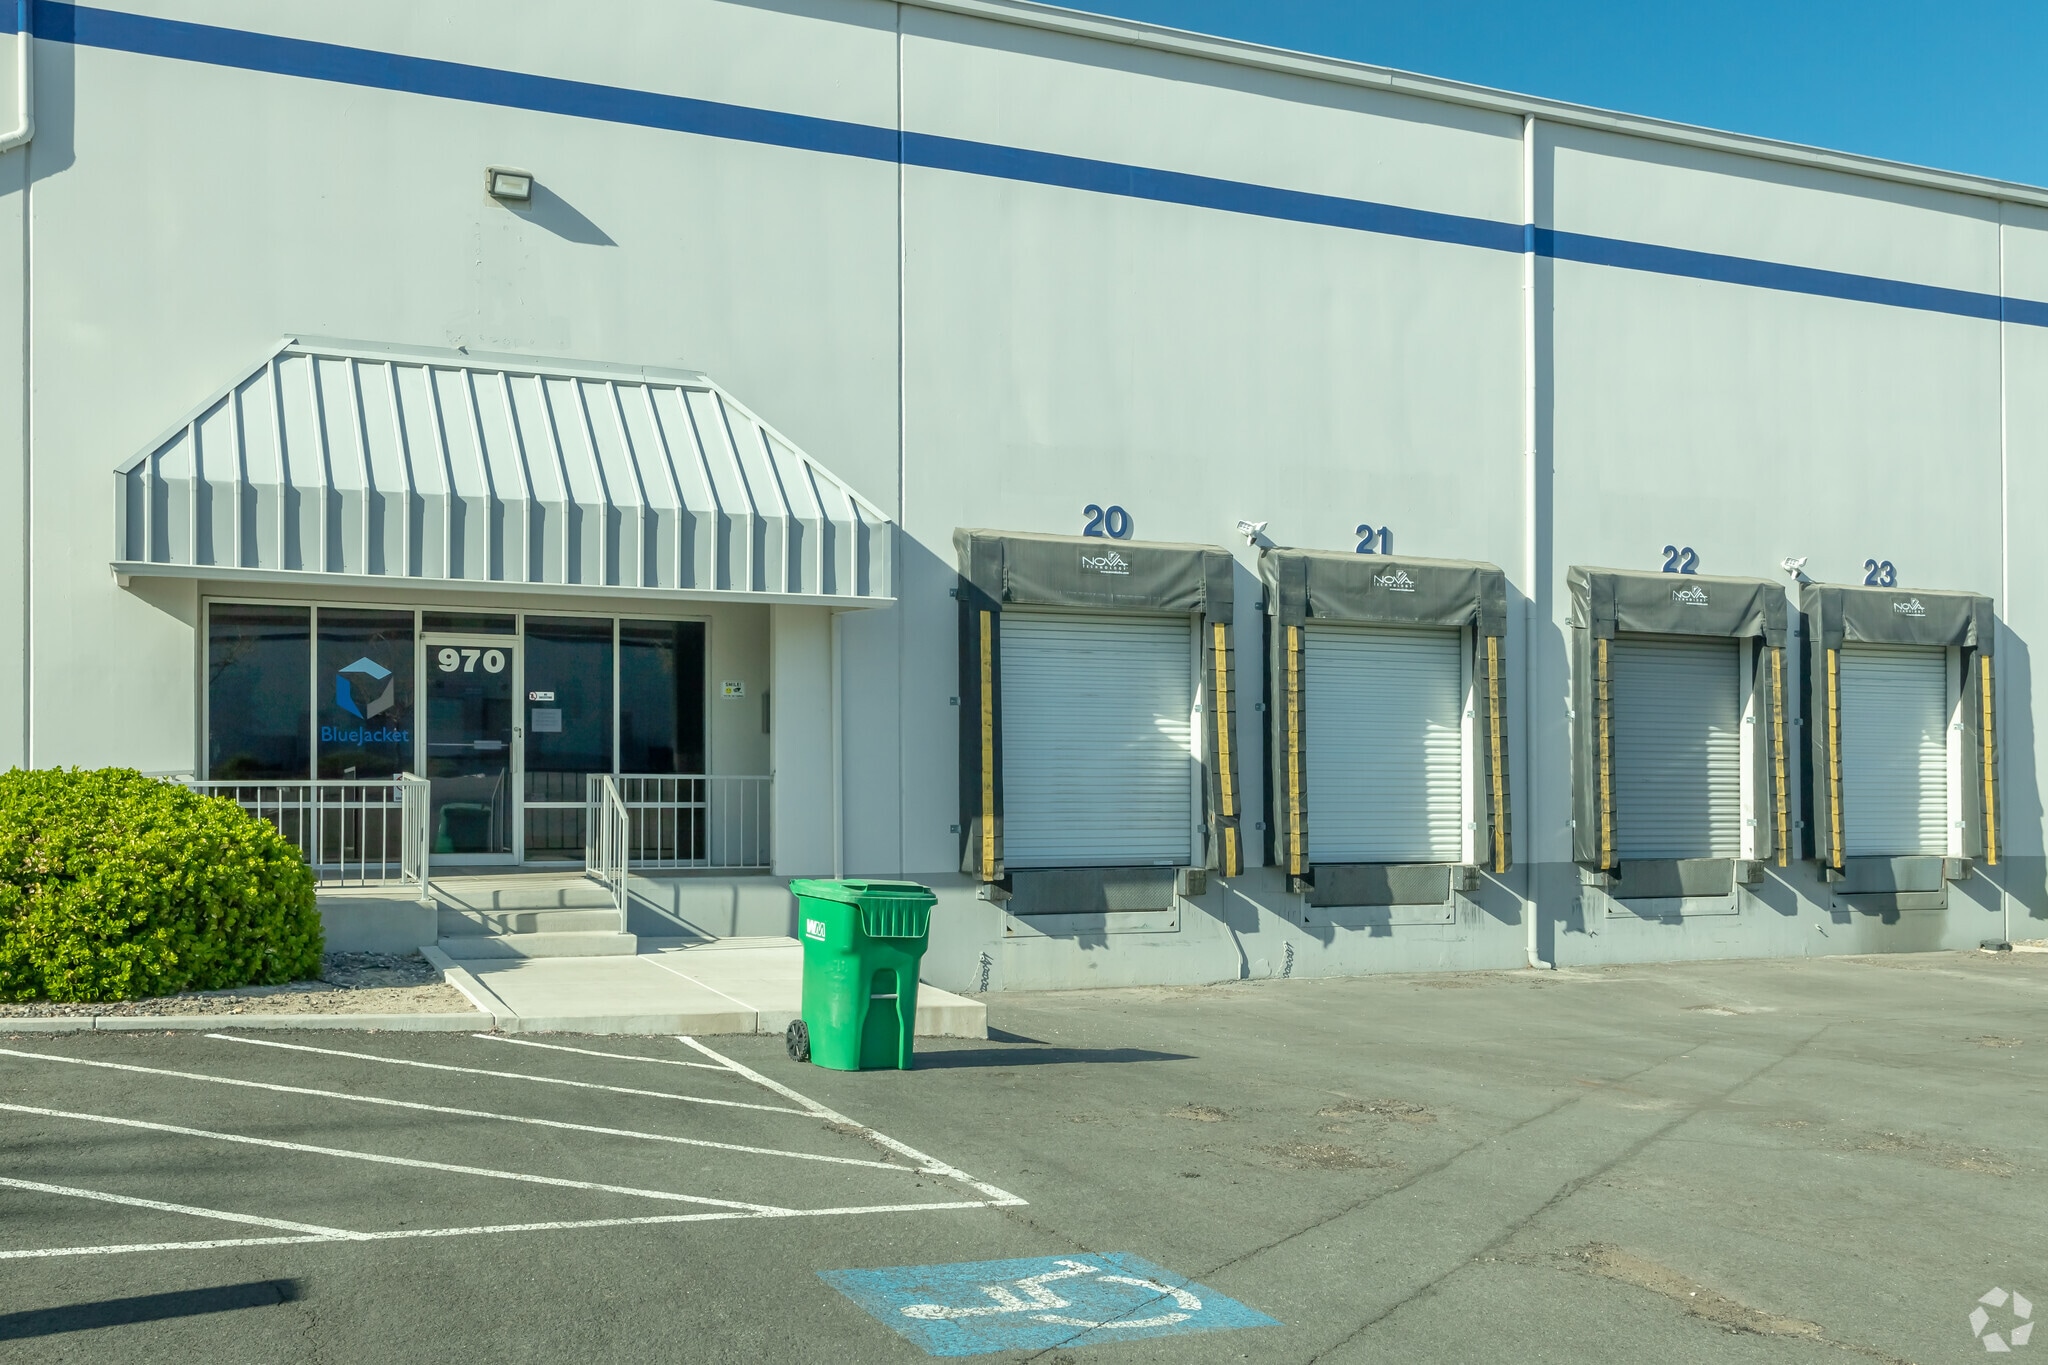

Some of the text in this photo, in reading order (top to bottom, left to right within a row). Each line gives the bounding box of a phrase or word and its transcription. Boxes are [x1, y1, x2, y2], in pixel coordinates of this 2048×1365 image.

[1083, 503, 1128, 538] 20
[1355, 524, 1388, 554] 21
[1082, 554, 1129, 567] NOVA
[1662, 544, 1696, 574] 22
[1373, 573, 1415, 585] NOVA
[1863, 558, 1894, 587] 23
[1672, 589, 1708, 599] NOVA
[1893, 601, 1925, 611] NOVA
[438, 648, 506, 674] 970
[321, 726, 409, 746] BlueJacket
[806, 918, 826, 938] WM
